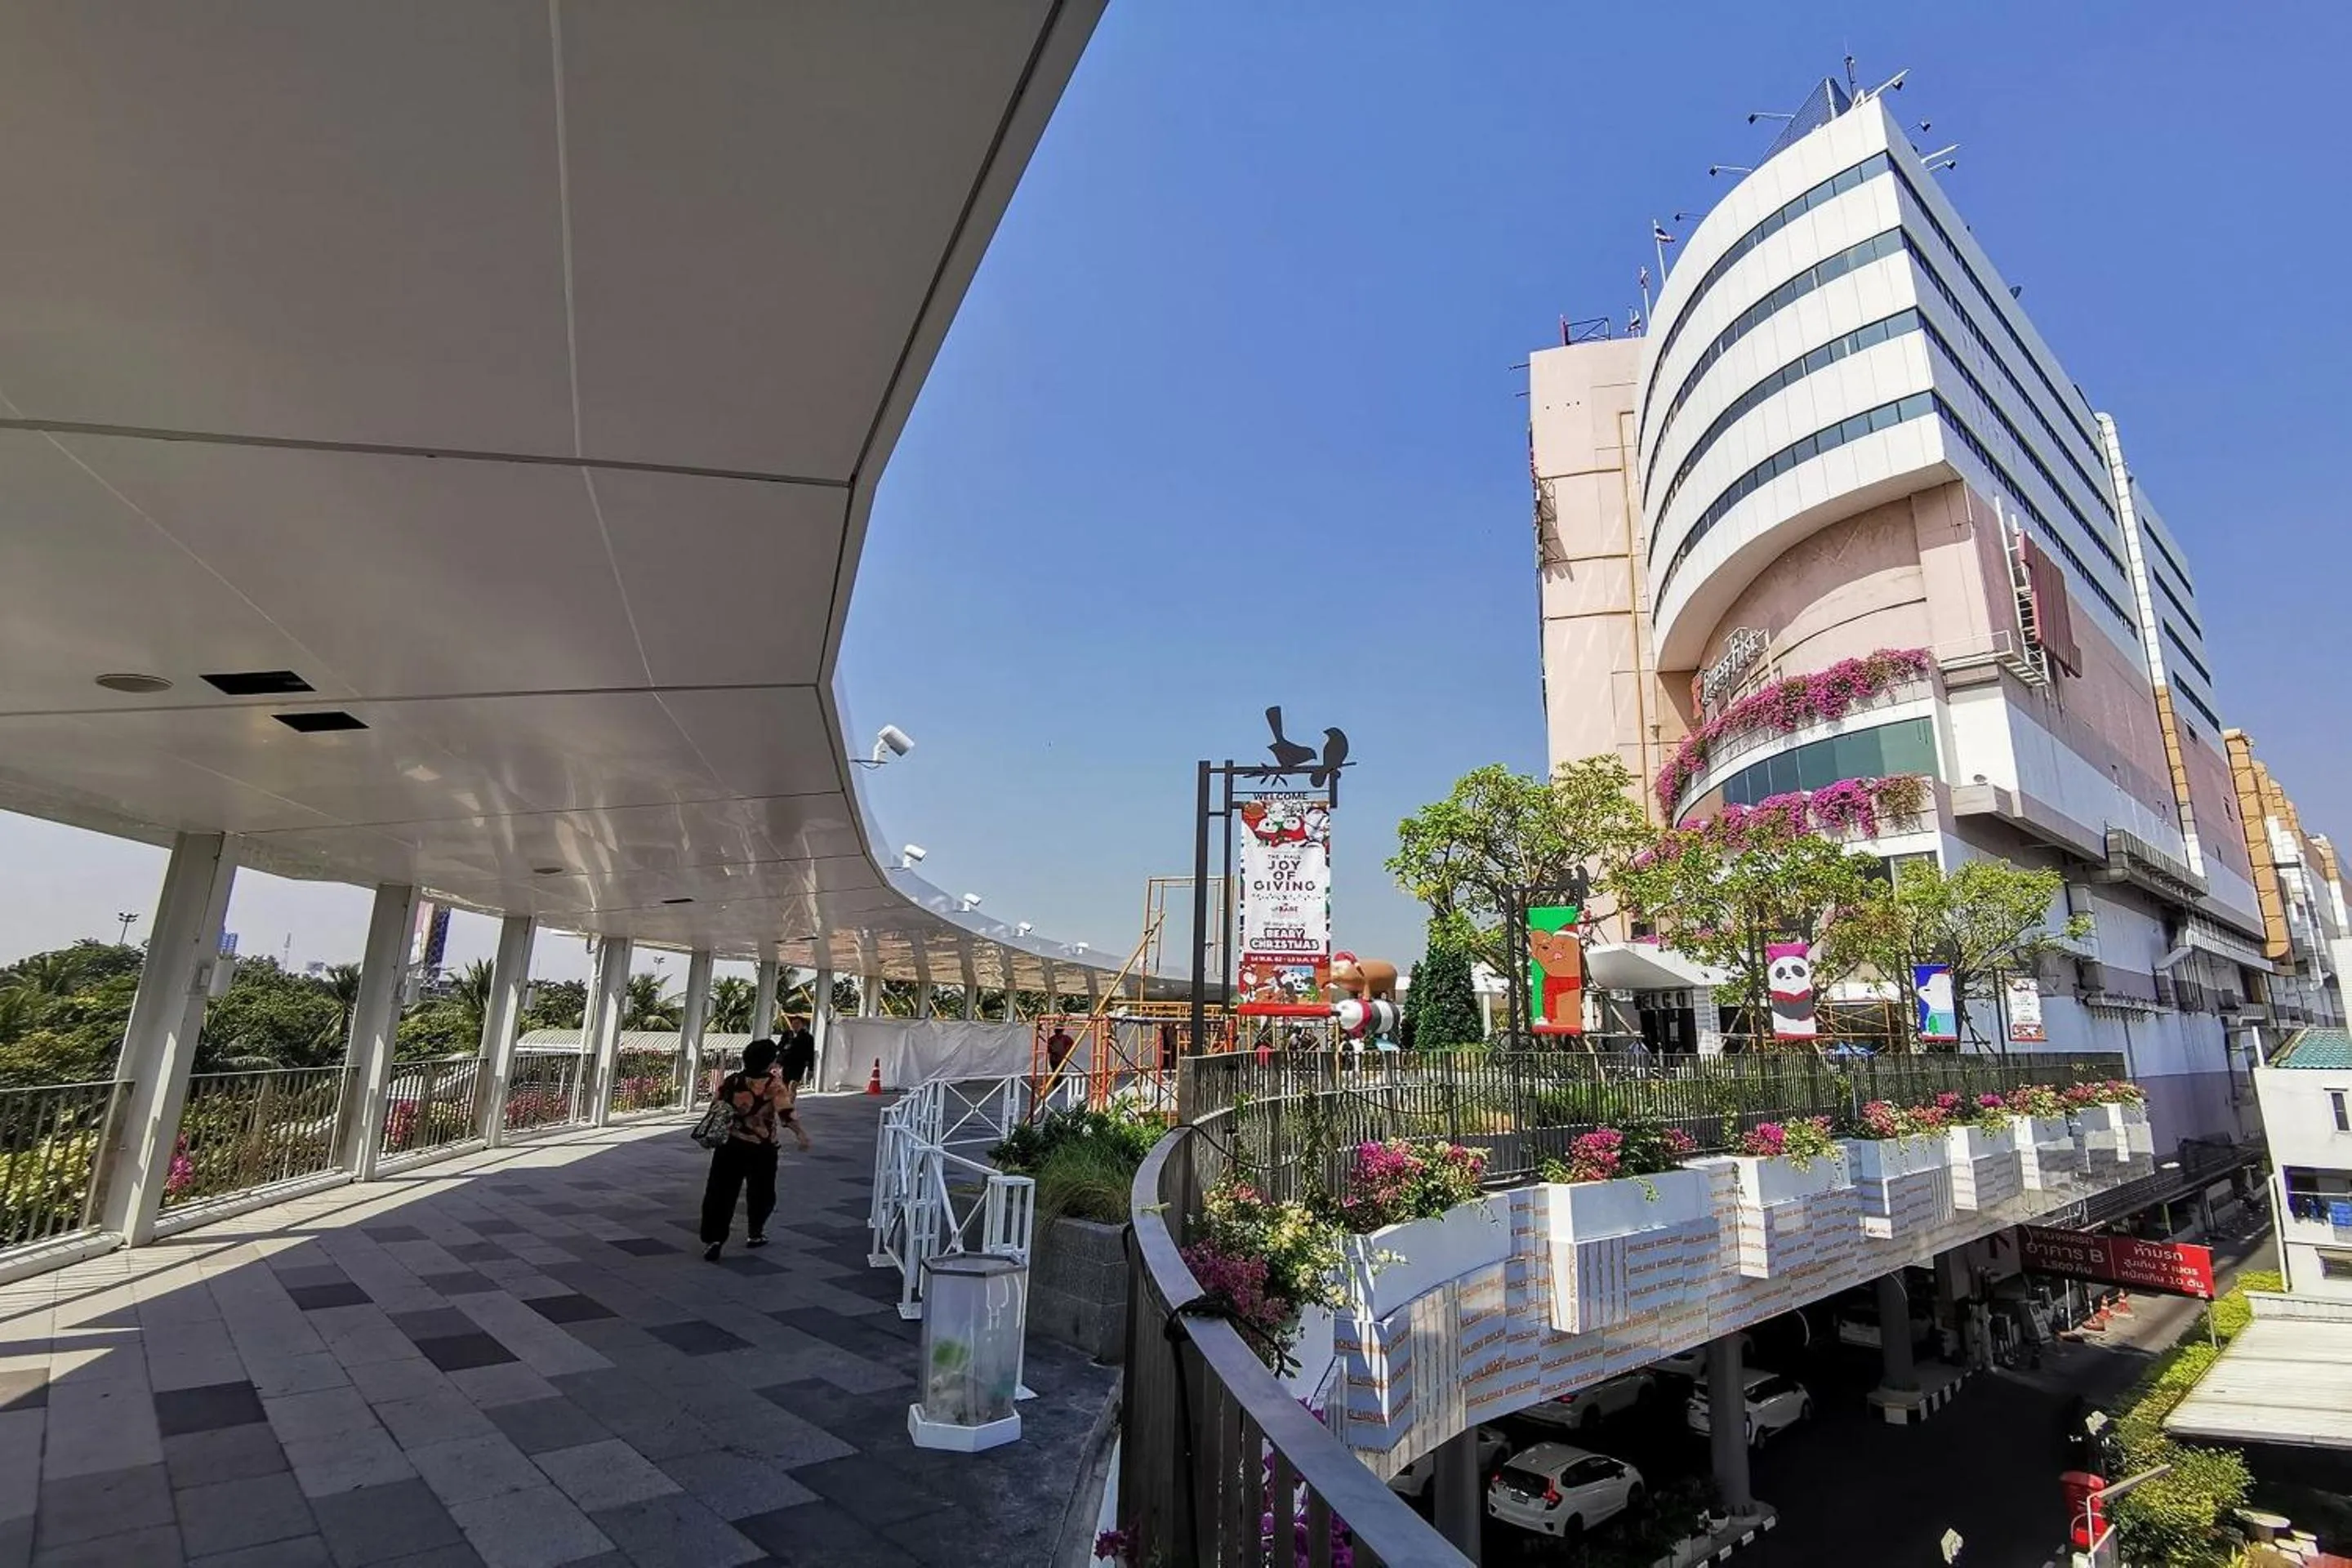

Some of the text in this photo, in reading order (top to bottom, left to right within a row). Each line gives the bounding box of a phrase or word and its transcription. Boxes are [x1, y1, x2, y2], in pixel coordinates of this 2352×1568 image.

[1254, 792, 1308, 800] WELCOME
[1267, 860, 1301, 871] JOY
[1272, 871, 1296, 880] OF
[1254, 880, 1316, 892] GIVING
[1265, 929, 1305, 938] BEARY
[1250, 938, 1319, 950] CHRISTMAS
[2025, 1242, 2105, 1263] อาคาร B
